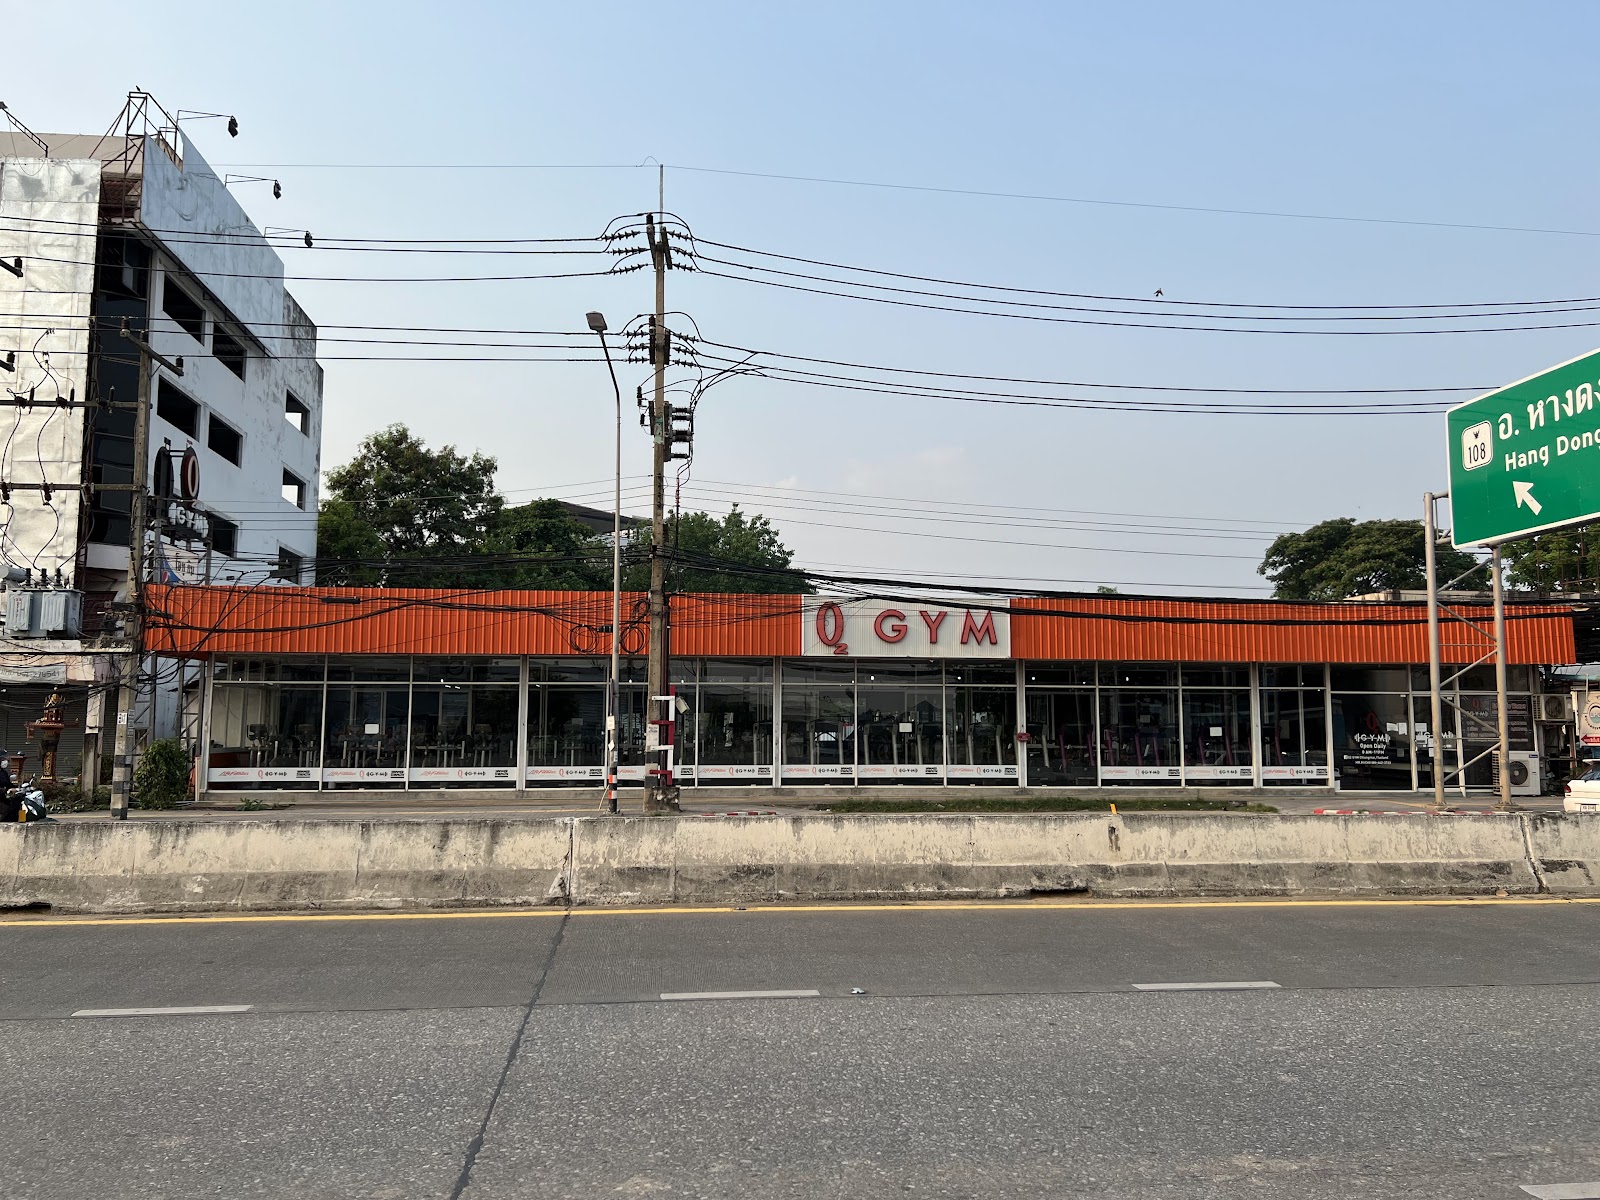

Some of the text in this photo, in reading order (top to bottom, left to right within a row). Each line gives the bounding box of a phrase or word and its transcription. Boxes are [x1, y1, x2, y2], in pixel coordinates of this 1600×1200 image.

[1498, 412, 1520, 440] อ.
[1468, 442, 1486, 464] 108
[1504, 444, 1549, 472] Hang
[1373, 742, 1387, 750] Daily
